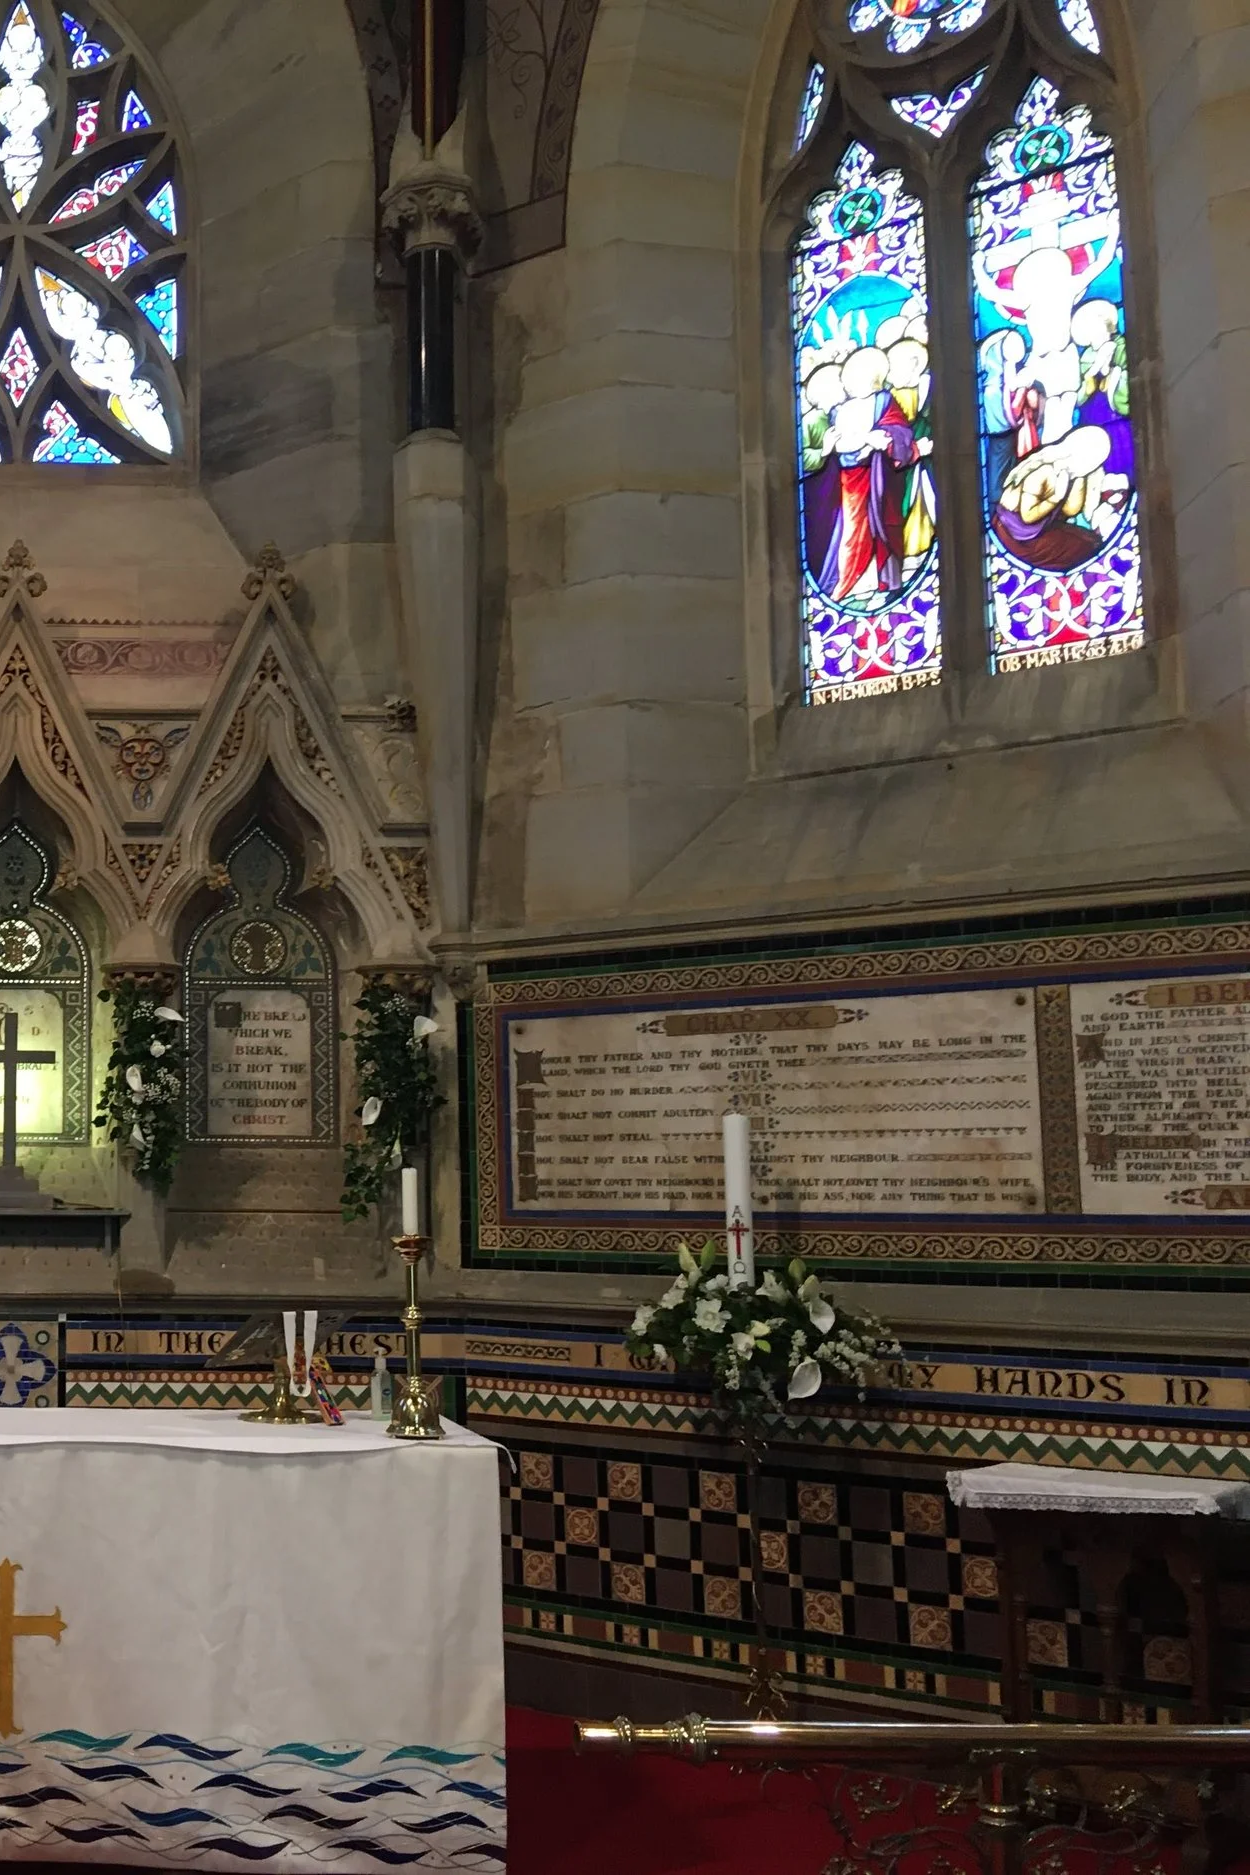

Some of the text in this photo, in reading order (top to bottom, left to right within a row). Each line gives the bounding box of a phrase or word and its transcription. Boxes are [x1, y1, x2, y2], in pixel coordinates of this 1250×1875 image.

[1167, 985, 1178, 1005] I
[1081, 1013, 1095, 1023] IN
[1100, 1011, 1130, 1022] GOD
[1136, 1009, 1164, 1020] THE
[1170, 1006, 1227, 1019] FATHER
[272, 1028, 293, 1039] WE
[1083, 1020, 1166, 1034] AND EARTH
[1150, 1031, 1248, 1046] JESUS CHRIST
[603, 1052, 644, 1064] FATHER
[651, 1050, 673, 1060] AND
[679, 1049, 702, 1059] THY
[768, 1044, 799, 1055] THAT
[806, 1043, 829, 1054] THY
[838, 1041, 870, 1052] DAYS
[877, 1039, 905, 1050] MAY
[912, 1038, 931, 1048] BE
[938, 1036, 973, 1047] LONG
[979, 1034, 993, 1045] IN
[1000, 1033, 1027, 1044] THE
[211, 1063, 224, 1073] IS
[227, 1063, 242, 1073] IT
[246, 1063, 274, 1073] NOT
[611, 1065, 632, 1075] THE
[635, 1063, 664, 1074] LORD
[668, 1062, 691, 1072] THY
[699, 1061, 722, 1071] GOD
[727, 1059, 770, 1070] GIVETH
[1137, 1056, 1185, 1067] VIRGIN
[222, 1080, 298, 1091] COMMUNION
[629, 1085, 673, 1097] MURDER
[255, 1098, 290, 1109] BODY
[291, 1098, 308, 1108] OF
[617, 1109, 658, 1119] COMMIT
[621, 1156, 649, 1165] BEAR
[653, 1154, 688, 1165] FALSE
[800, 1154, 826, 1164] THY
[1126, 1160, 1244, 1172] FORGIVENESS OF
[1091, 1172, 1119, 1183] THE
[1170, 1172, 1198, 1183] AND
[1205, 1171, 1233, 1182] THE
[731, 1204, 744, 1218] A
[89, 1330, 409, 1357] IN THE HEST
[594, 1343, 604, 1369] I
[973, 1365, 1126, 1402] HANDS
[1164, 1376, 1212, 1407] IN
